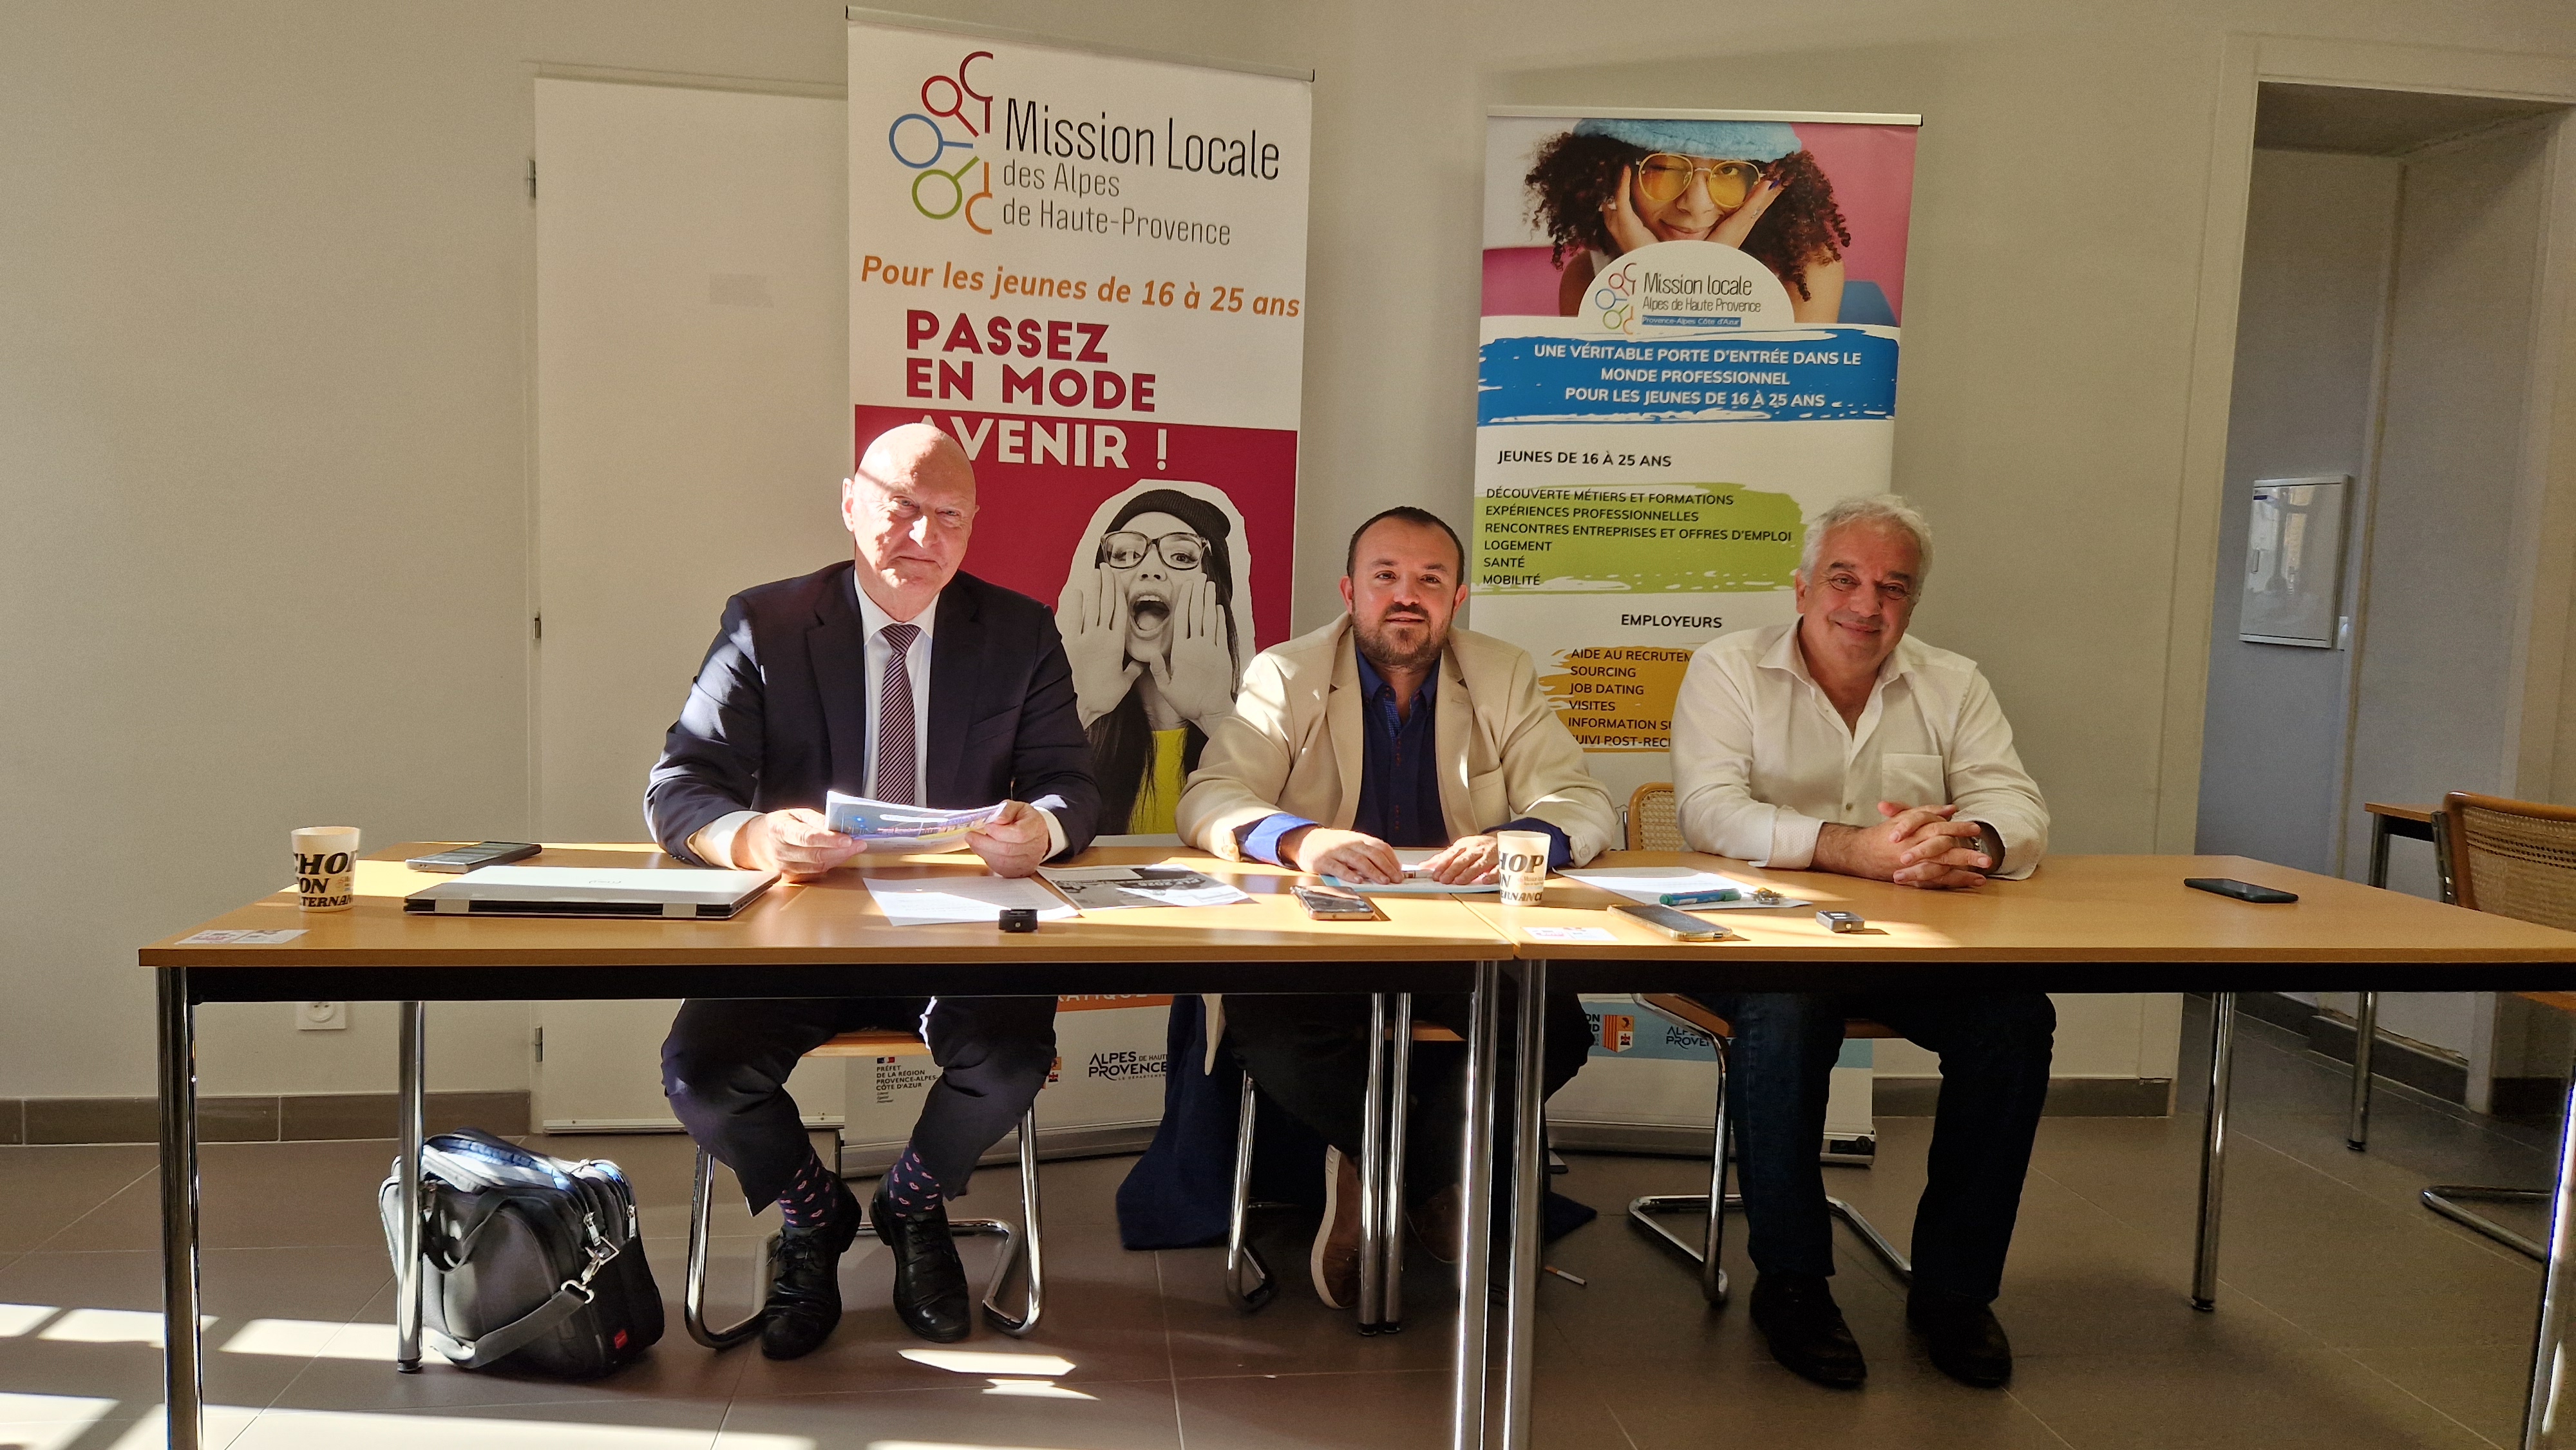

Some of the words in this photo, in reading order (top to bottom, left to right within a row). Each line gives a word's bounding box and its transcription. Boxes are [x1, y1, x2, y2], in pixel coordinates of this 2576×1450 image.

[1005, 98, 1154, 167] Mission
[1168, 117, 1280, 180] Locale
[1003, 159, 1045, 190] des
[1054, 164, 1120, 197] Alpes
[1003, 198, 1030, 227] de
[1040, 200, 1231, 245] Haute-Provence
[861, 255, 934, 287] Pour
[942, 261, 984, 291] les
[990, 266, 1087, 301] jeunes
[1097, 276, 1132, 304] de
[1142, 280, 1175, 308] 16
[1184, 281, 1200, 310] à
[1210, 286, 1244, 312] 25
[1253, 295, 1301, 317] ans
[1643, 272, 1702, 295] Mission
[1707, 275, 1752, 296] locale
[1642, 296, 1668, 312] Alpes
[1671, 298, 1683, 311] de
[1685, 298, 1713, 311] Haute
[1716, 298, 1761, 312] Provence
[906, 308, 1110, 364] PASSEZ
[1534, 344, 1566, 359] UNE
[1569, 343, 1653, 361] VÉRITABLE
[1657, 349, 1710, 362] PORTE
[1713, 348, 1789, 364] D'ENTRÉE
[1793, 351, 1839, 366] DANS
[1843, 352, 1861, 366] LE
[906, 357, 974, 401] EN
[1002, 364, 1156, 413] MODE
[1600, 367, 1657, 383] MONDE
[1661, 370, 1790, 386] PROFESSIONNEL
[1565, 387, 1608, 402] POUR
[1612, 389, 1640, 403] LES
[1643, 390, 1701, 405] JEUNES
[1705, 391, 1727, 406] DE
[1730, 391, 1749, 406] 16
[1752, 390, 1766, 406] À
[1768, 393, 1788, 407] 25
[1790, 393, 1825, 407] ANS
[919, 414, 1130, 470] VENIR
[1157, 429, 1167, 471] !
[1497, 449, 1553, 465] JEUNES
[1557, 452, 1578, 464] DE
[1582, 453, 1599, 465] 16
[1602, 450, 1615, 466] À
[1618, 454, 1636, 466] 25
[1639, 455, 1672, 467] ANS
[1486, 486, 1570, 501] DÉCOUVERTE
[1573, 488, 1627, 503] MÉTIERS
[1629, 492, 1646, 504] ET
[1648, 493, 1734, 505] FORMATIONS
[1485, 504, 1569, 519] EXPÉRIENCES
[1573, 507, 1700, 522] PROFESSIONNELLES
[1484, 523, 1569, 536] RENCONTRES
[1572, 525, 1657, 539] ENTREPRISES
[1660, 528, 1676, 539] ET
[1679, 528, 1728, 541] OFFRES
[1731, 530, 1792, 542] D'EMPLOI
[1484, 540, 1553, 552] LOGEMENT
[1483, 556, 1526, 569] SANTÉ
[1482, 573, 1541, 587] MOBILITÉ
[1621, 614, 1723, 628] EMPLOYEURS
[1571, 648, 1601, 660] AIDE
[1604, 650, 1622, 661] AU
[1570, 666, 1636, 678] SOURCING
[1569, 683, 1593, 695] JOB
[1596, 684, 1645, 695] DATING
[1569, 700, 1616, 711] VISITES
[1568, 717, 1656, 730] INFORMATION
[1573, 735, 1600, 745] UIVI
[1604, 735, 1671, 748] POST-REC
[1089, 1051, 1137, 1068] ALPES
